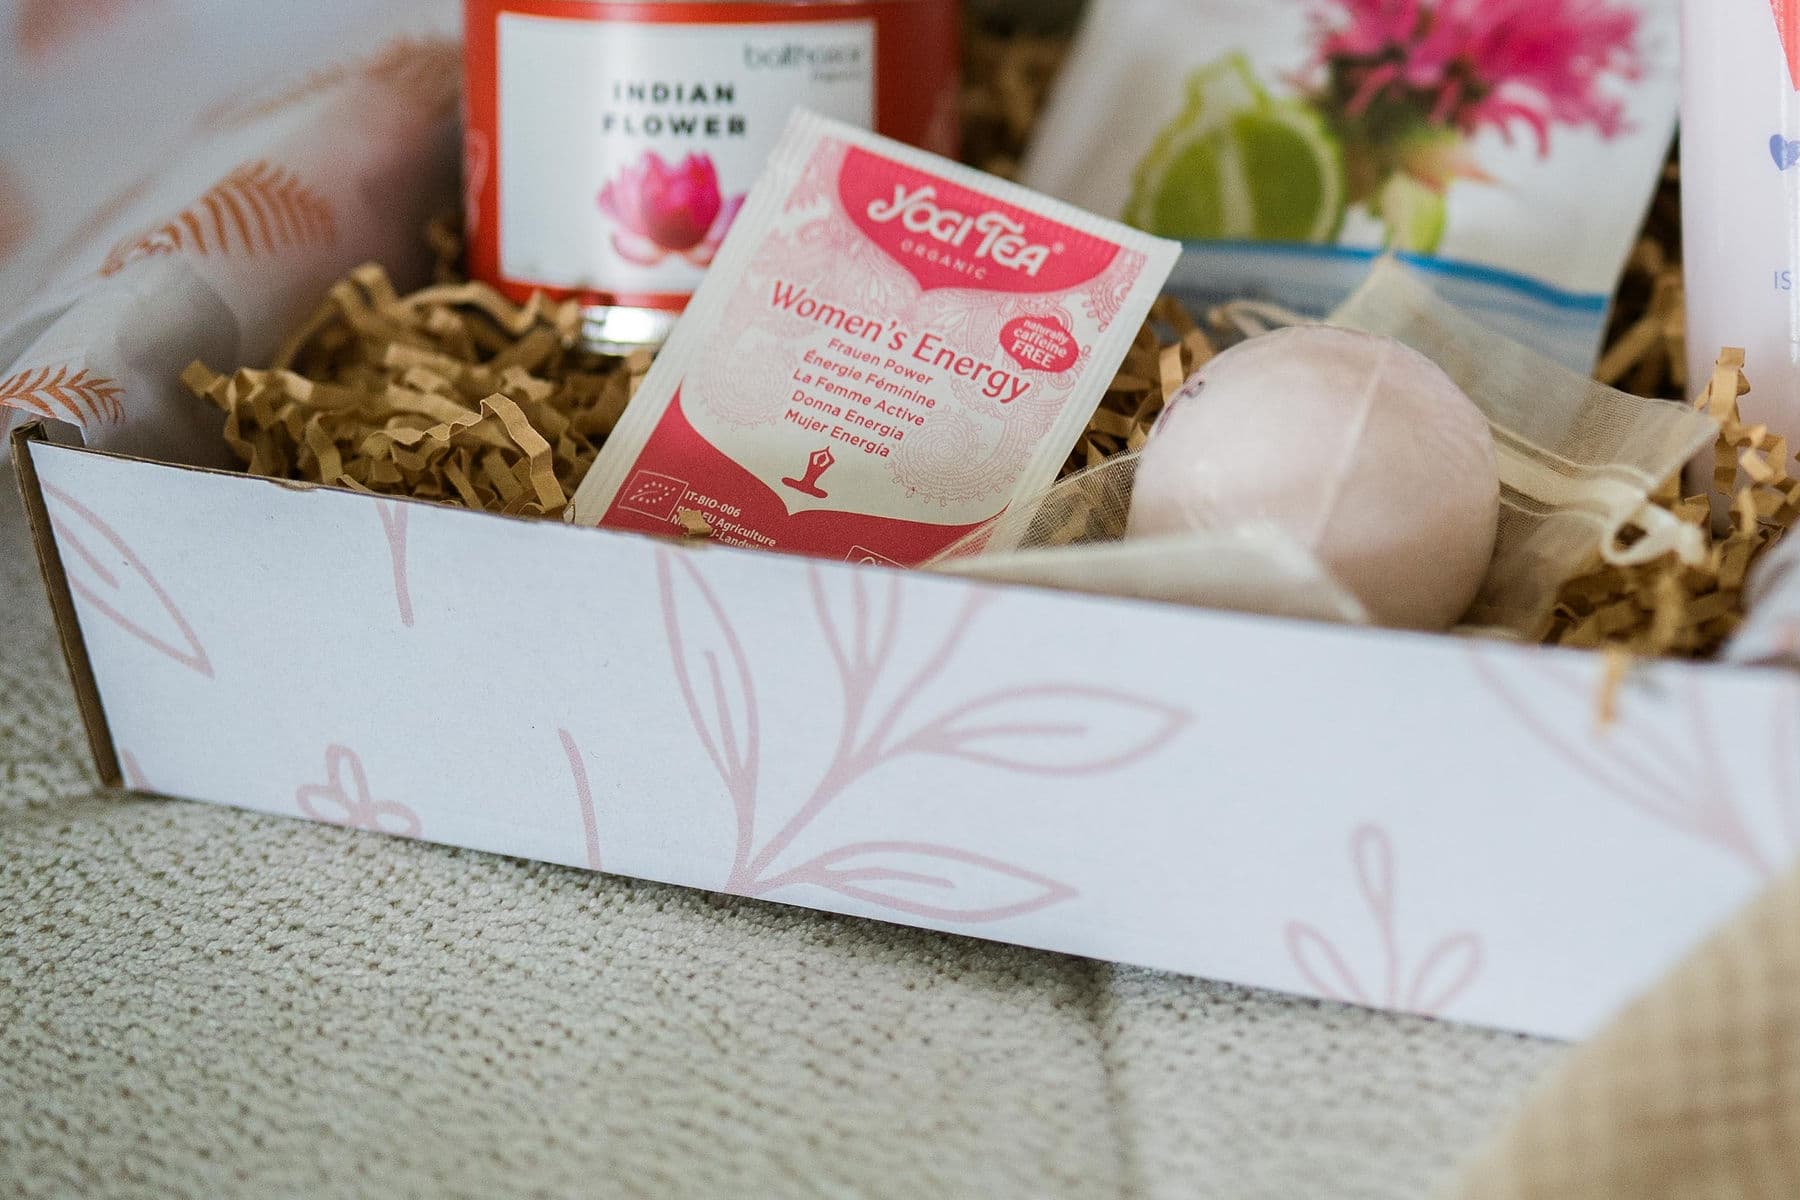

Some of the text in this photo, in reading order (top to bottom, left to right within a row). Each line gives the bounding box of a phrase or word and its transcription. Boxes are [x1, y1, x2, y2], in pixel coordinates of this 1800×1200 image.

[613, 82, 735, 102] INDIAN
[602, 114, 746, 136] FLOWER
[901, 239, 987, 280] ORGANIC
[1773, 270, 1791, 290] IS
[1013, 328, 1067, 358] caffeine
[1023, 320, 1069, 345] naturally
[828, 338, 934, 385] Frauen Power
[912, 333, 1030, 404] Energy
[1011, 340, 1056, 369] FREE
[803, 349, 936, 409] Énergie Féminine
[793, 368, 925, 426] La Femme Active
[791, 390, 904, 441] Donna Energia
[784, 409, 890, 457] Mujer Energía
[684, 490, 741, 518] IT-BIO-006
[715, 518, 776, 547] Agriculture
